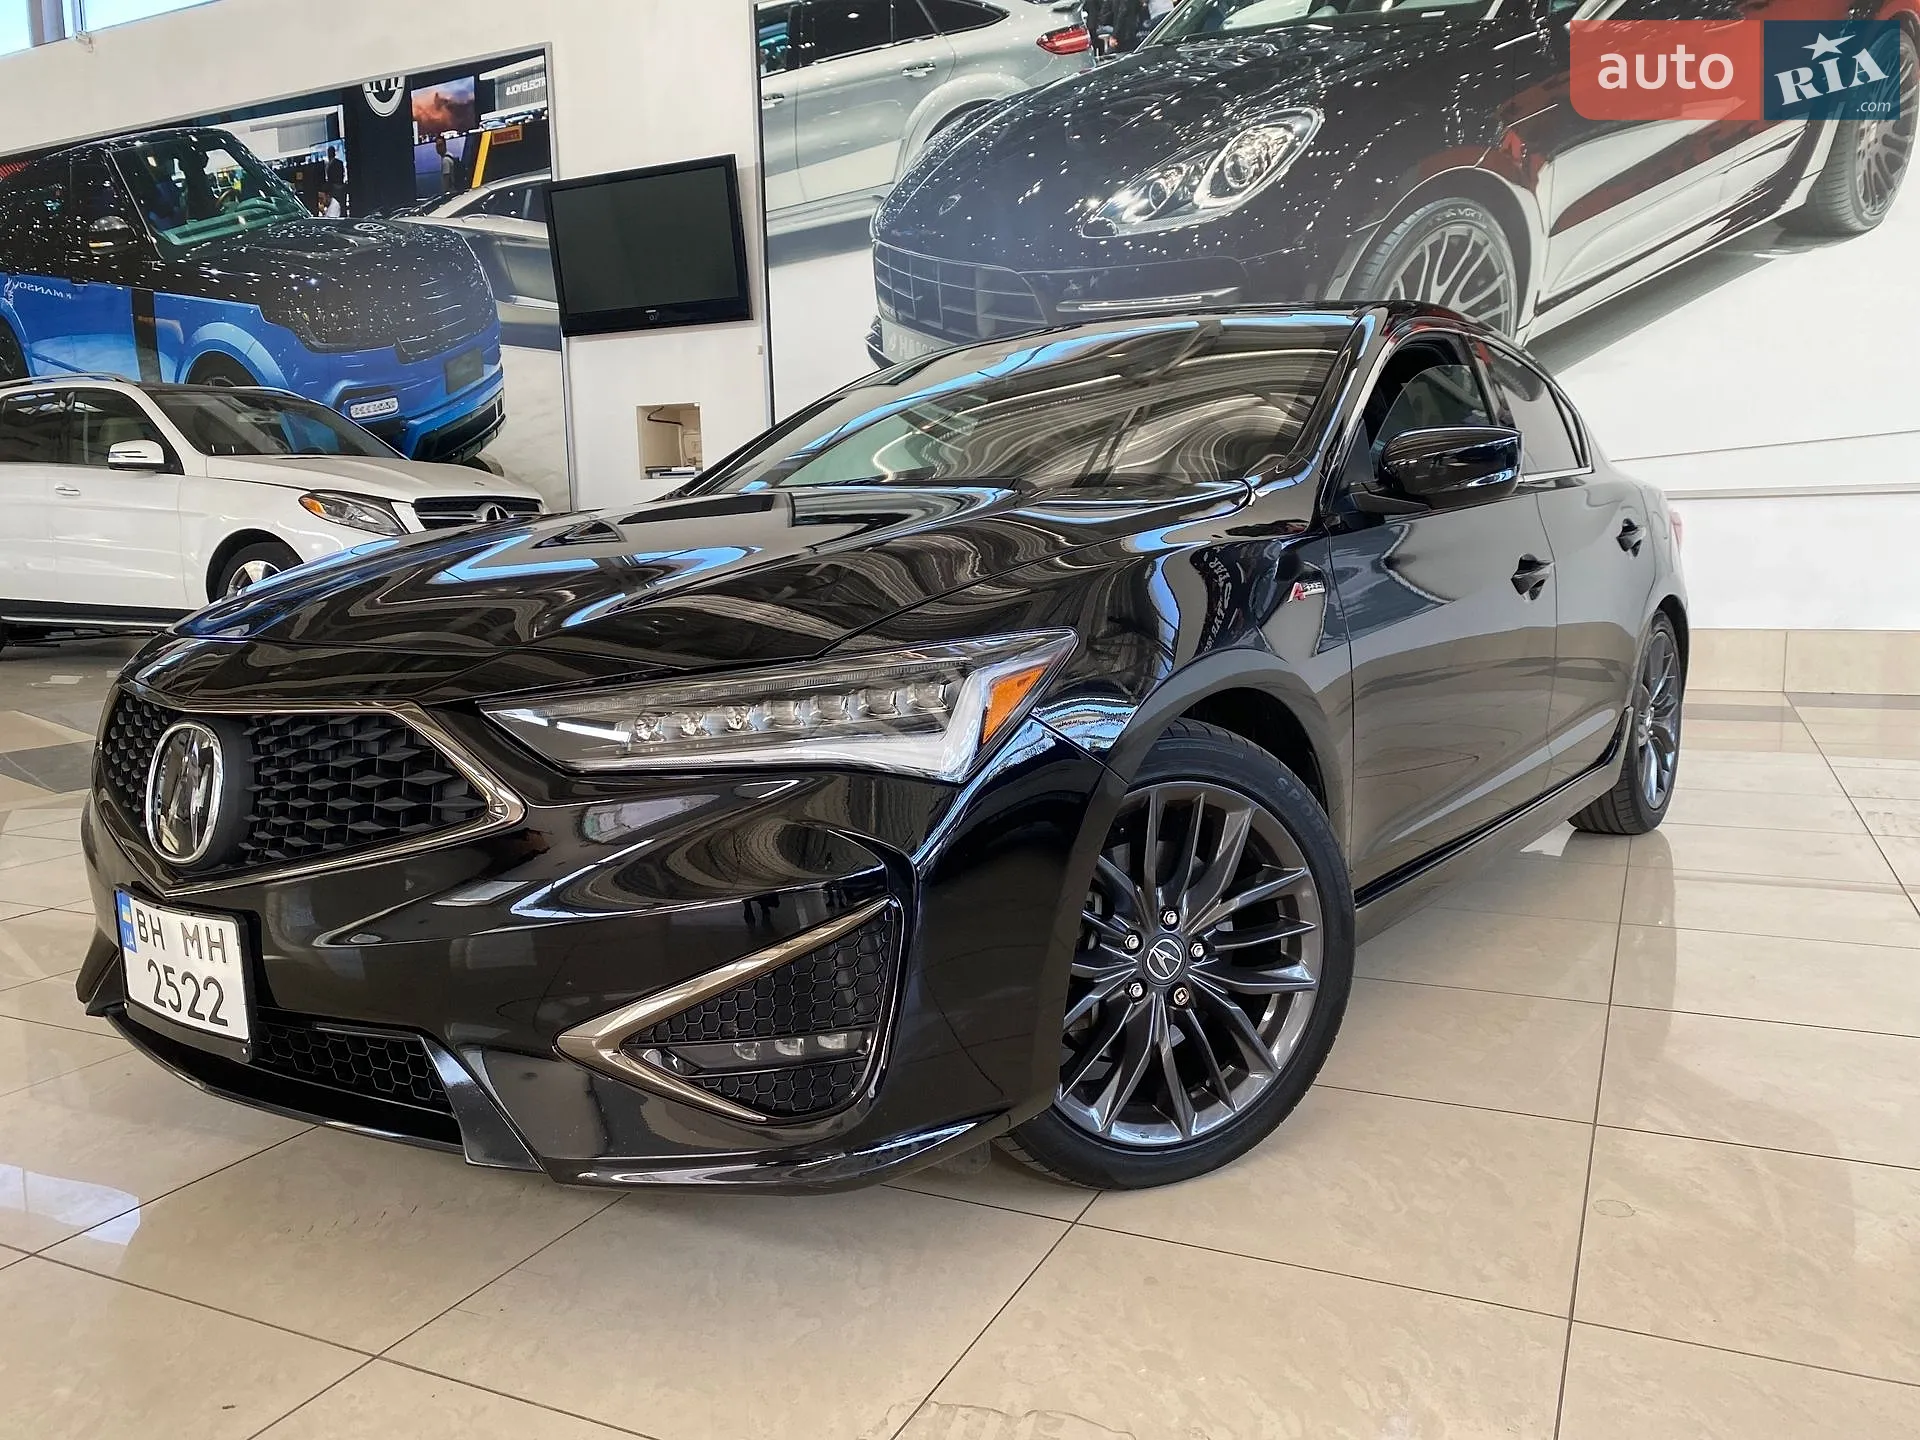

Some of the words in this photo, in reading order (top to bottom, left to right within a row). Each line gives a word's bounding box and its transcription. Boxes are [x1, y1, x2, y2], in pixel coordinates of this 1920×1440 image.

[123, 930, 135, 947] UA
[136, 907, 166, 951] BH
[180, 922, 227, 964] MH
[147, 958, 229, 1027] 2522
